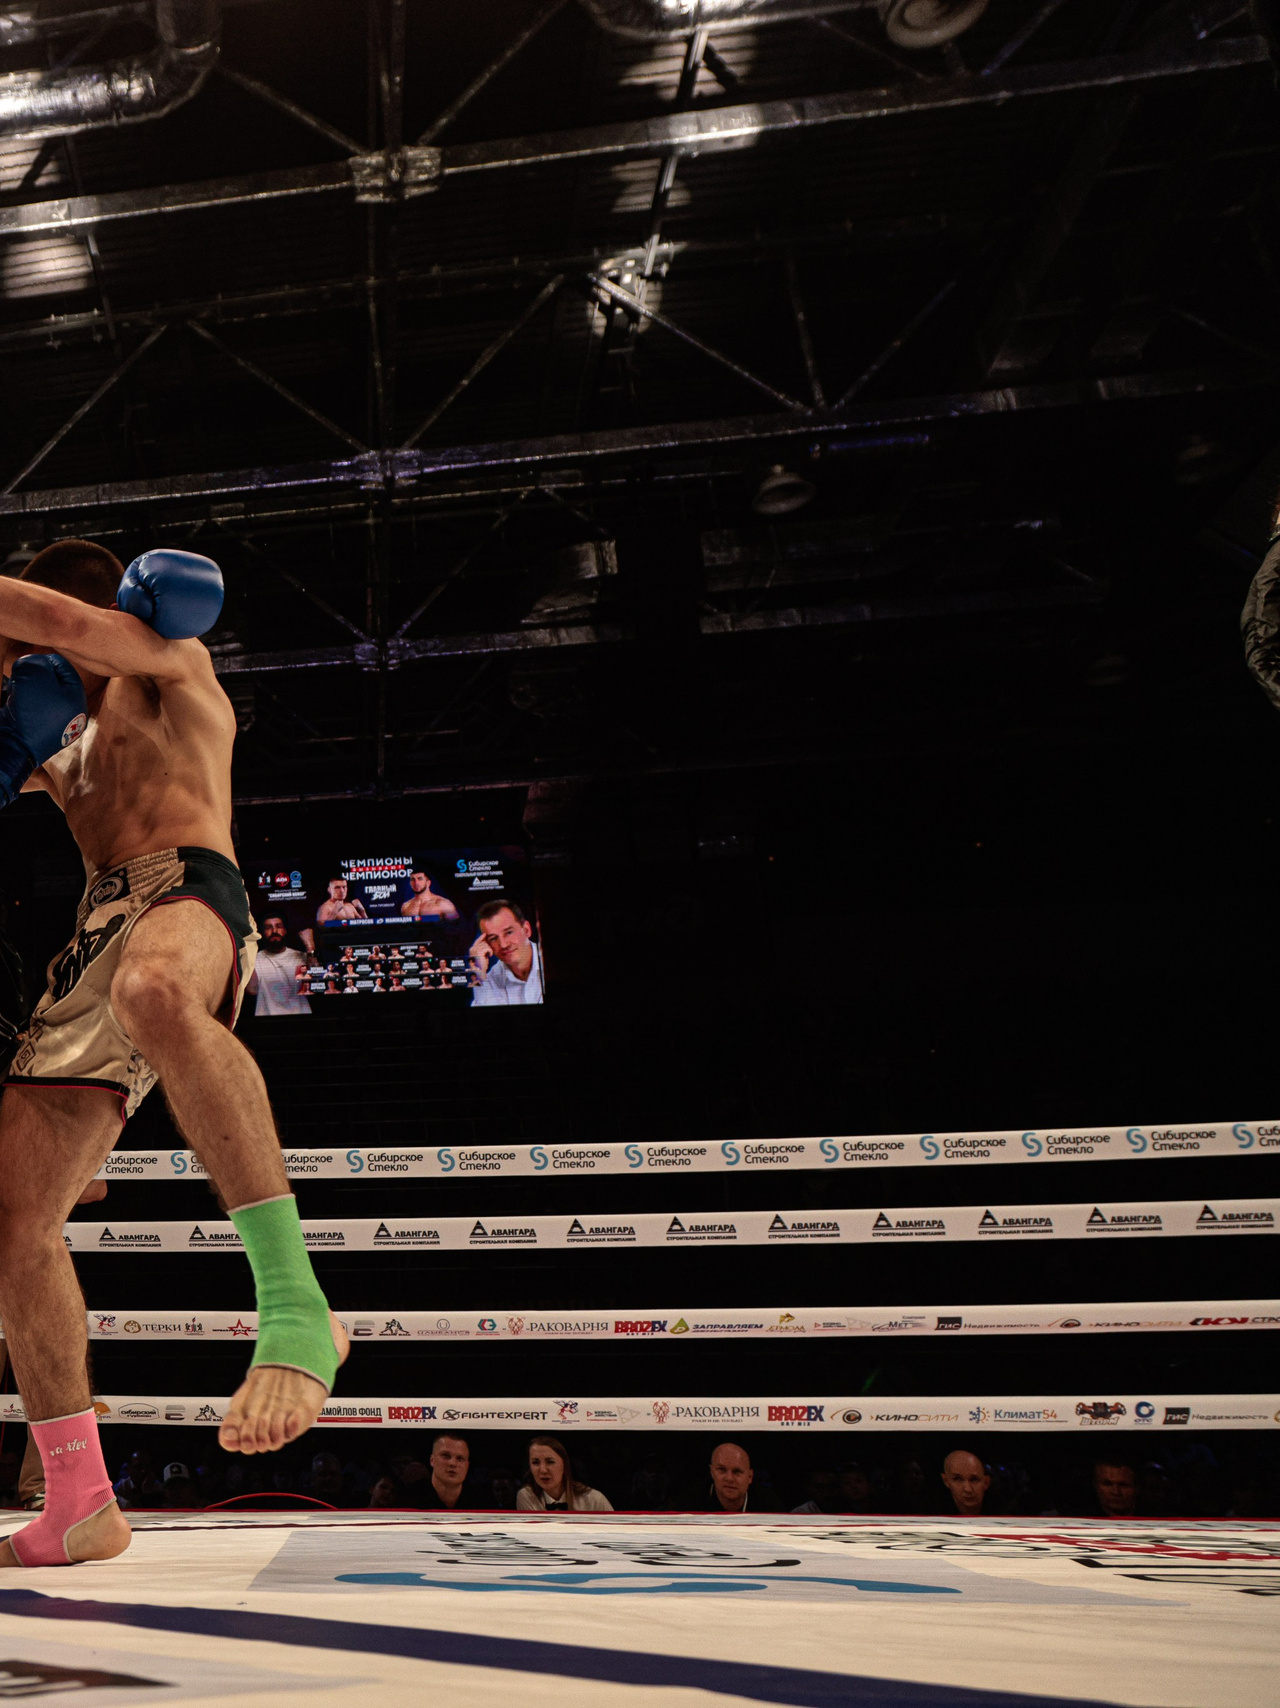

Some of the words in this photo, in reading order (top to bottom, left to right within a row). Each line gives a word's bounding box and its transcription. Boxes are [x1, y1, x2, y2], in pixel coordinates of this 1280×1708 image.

[341, 857, 413, 868] ЧЕМПИОНЫ
[365, 884, 397, 893] ГЛАВНЫЙ
[1046, 1134, 1111, 1146] Сибирское
[1151, 1129, 1217, 1141] Сибирское
[843, 1141, 905, 1152] Сибирское
[943, 1137, 1007, 1150] Сибирское
[1152, 1141, 1200, 1151] Стекло
[552, 1149, 610, 1160] Сибирское
[647, 1147, 707, 1158] Сибирское
[744, 1144, 805, 1155] Сибирское
[944, 1148, 990, 1159] Стекло
[1047, 1145, 1094, 1156] Стекло
[105, 1156, 158, 1166] Сибирское
[283, 1154, 333, 1164] ибирское
[367, 1152, 424, 1165] Сибирское
[459, 1151, 516, 1162] Сибирское
[744, 1154, 789, 1164] Стекло
[843, 1151, 888, 1161] Стекло
[367, 1162, 409, 1172] Стекло
[459, 1161, 501, 1171] Стекло
[552, 1159, 595, 1169] Стекло
[647, 1157, 691, 1167] Стекло
[106, 1166, 144, 1174] Стекло
[1002, 1217, 1053, 1226] АВАНГАРД
[1110, 1215, 1162, 1224] АВАНГАРД
[1221, 1212, 1274, 1221] АВАНГАРД
[688, 1224, 737, 1234] АВАНГАРД
[791, 1222, 839, 1231] АВАНГАРД
[895, 1220, 945, 1229] АВАНГАРД
[394, 1230, 440, 1239] АВАНГАРД
[491, 1228, 536, 1237] АВАНГАРД
[589, 1226, 636, 1235] АВАНГАРД
[530, 1322, 608, 1331] РАКОВАРНЯ
[614, 1320, 668, 1333] BROZEX
[319, 1406, 357, 1416] АМОЙЛОВ
[359, 1407, 382, 1416] ФОНД
[388, 1406, 437, 1419] BROZEX
[461, 1411, 548, 1421] FIGHTEXPERT
[676, 1406, 759, 1417] РАКОВАРНЯ
[768, 1406, 824, 1421] BROZEX
[993, 1409, 1058, 1420] Климат54
[1165, 1413, 1188, 1421] ГИС
